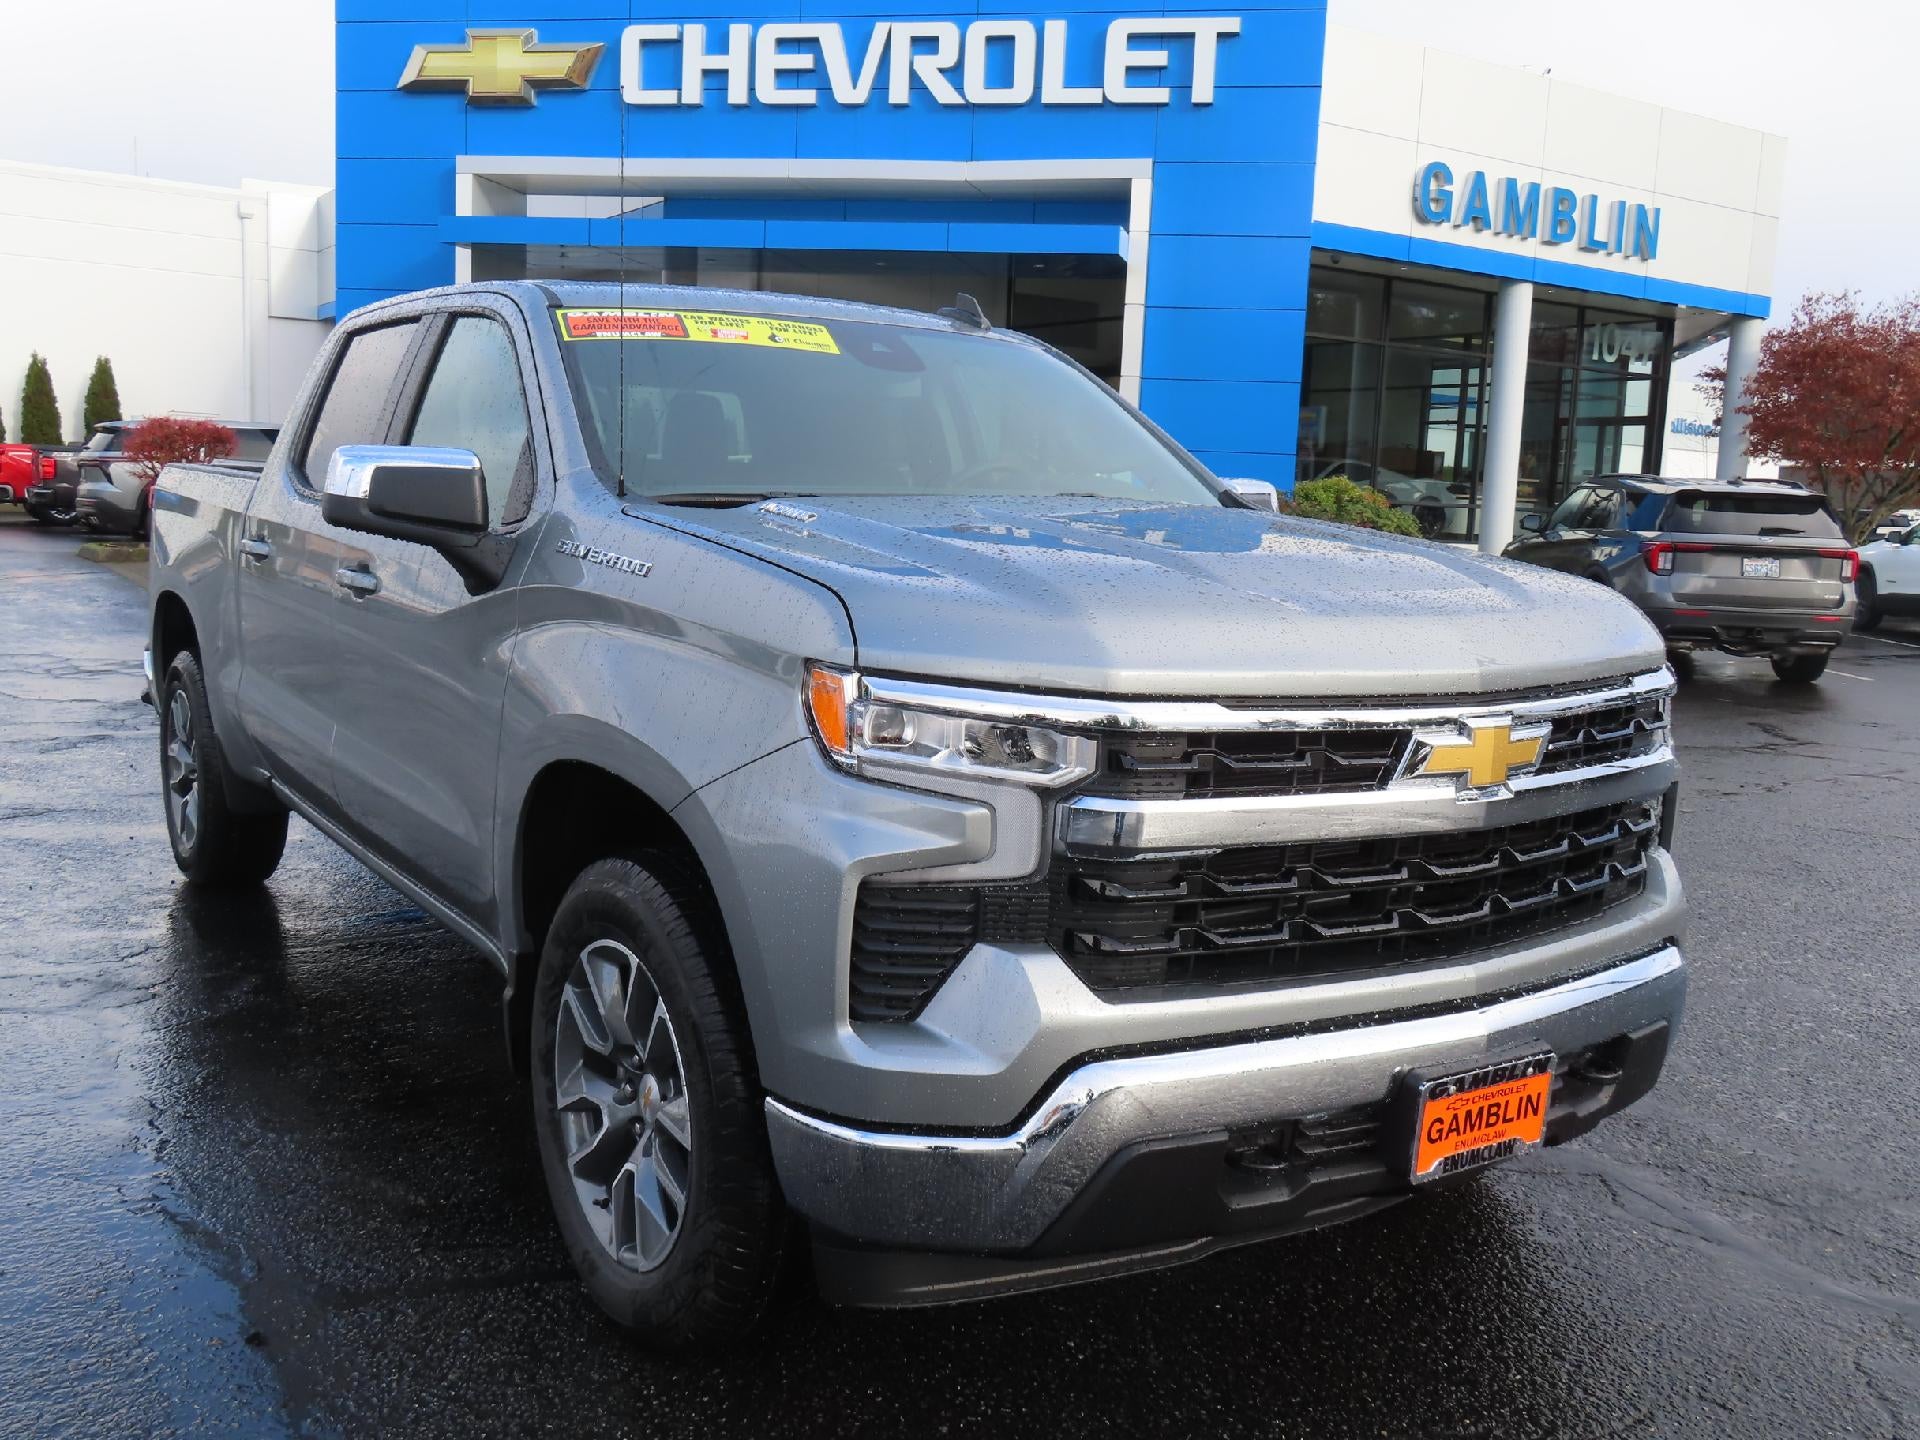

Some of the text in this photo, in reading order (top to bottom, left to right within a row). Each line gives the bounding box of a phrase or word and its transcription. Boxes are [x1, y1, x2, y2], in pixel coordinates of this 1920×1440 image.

[620, 17, 1241, 107] CHEVROLET
[1413, 161, 1661, 261] GAMBLIN
[573, 323, 681, 332] GAMBLIN ADVANTAGE
[556, 538, 653, 577] SILVERADO
[1471, 1083, 1528, 1105] CHEVROLET
[1426, 1092, 1542, 1145] GAMBLIN
[1454, 1128, 1507, 1151] ENUMCLAW
